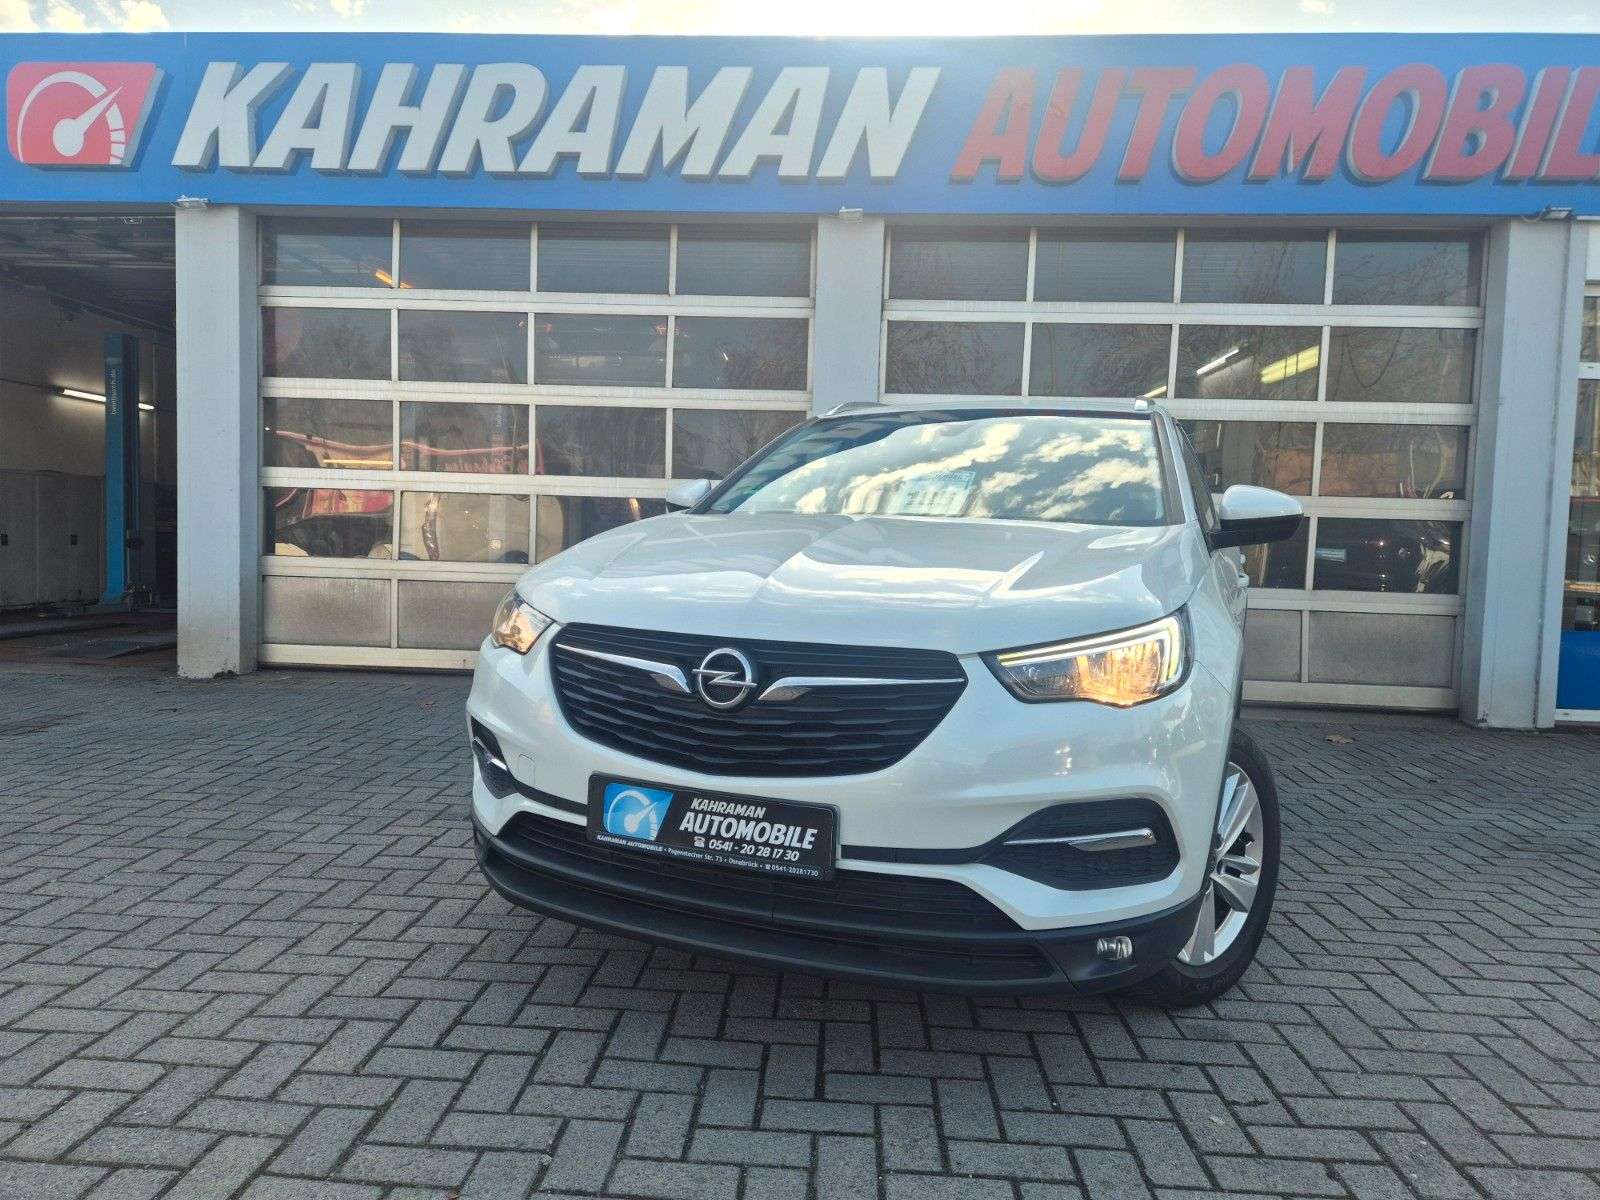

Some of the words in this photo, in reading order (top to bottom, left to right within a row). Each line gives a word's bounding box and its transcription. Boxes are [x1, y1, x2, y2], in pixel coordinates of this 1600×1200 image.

[172, 61, 942, 178] KAHRAMAN
[690, 798, 766, 818] KAHRAMAN
[679, 811, 818, 850] AUTOMOBILE
[597, 834, 627, 846] KAHRAMAN
[627, 841, 663, 852] AUTOMOBILE
[708, 839, 733, 852] 0541
[740, 843, 755, 855] 20
[756, 846, 771, 857] 28
[772, 848, 783, 859] 17
[783, 850, 800, 862] 30
